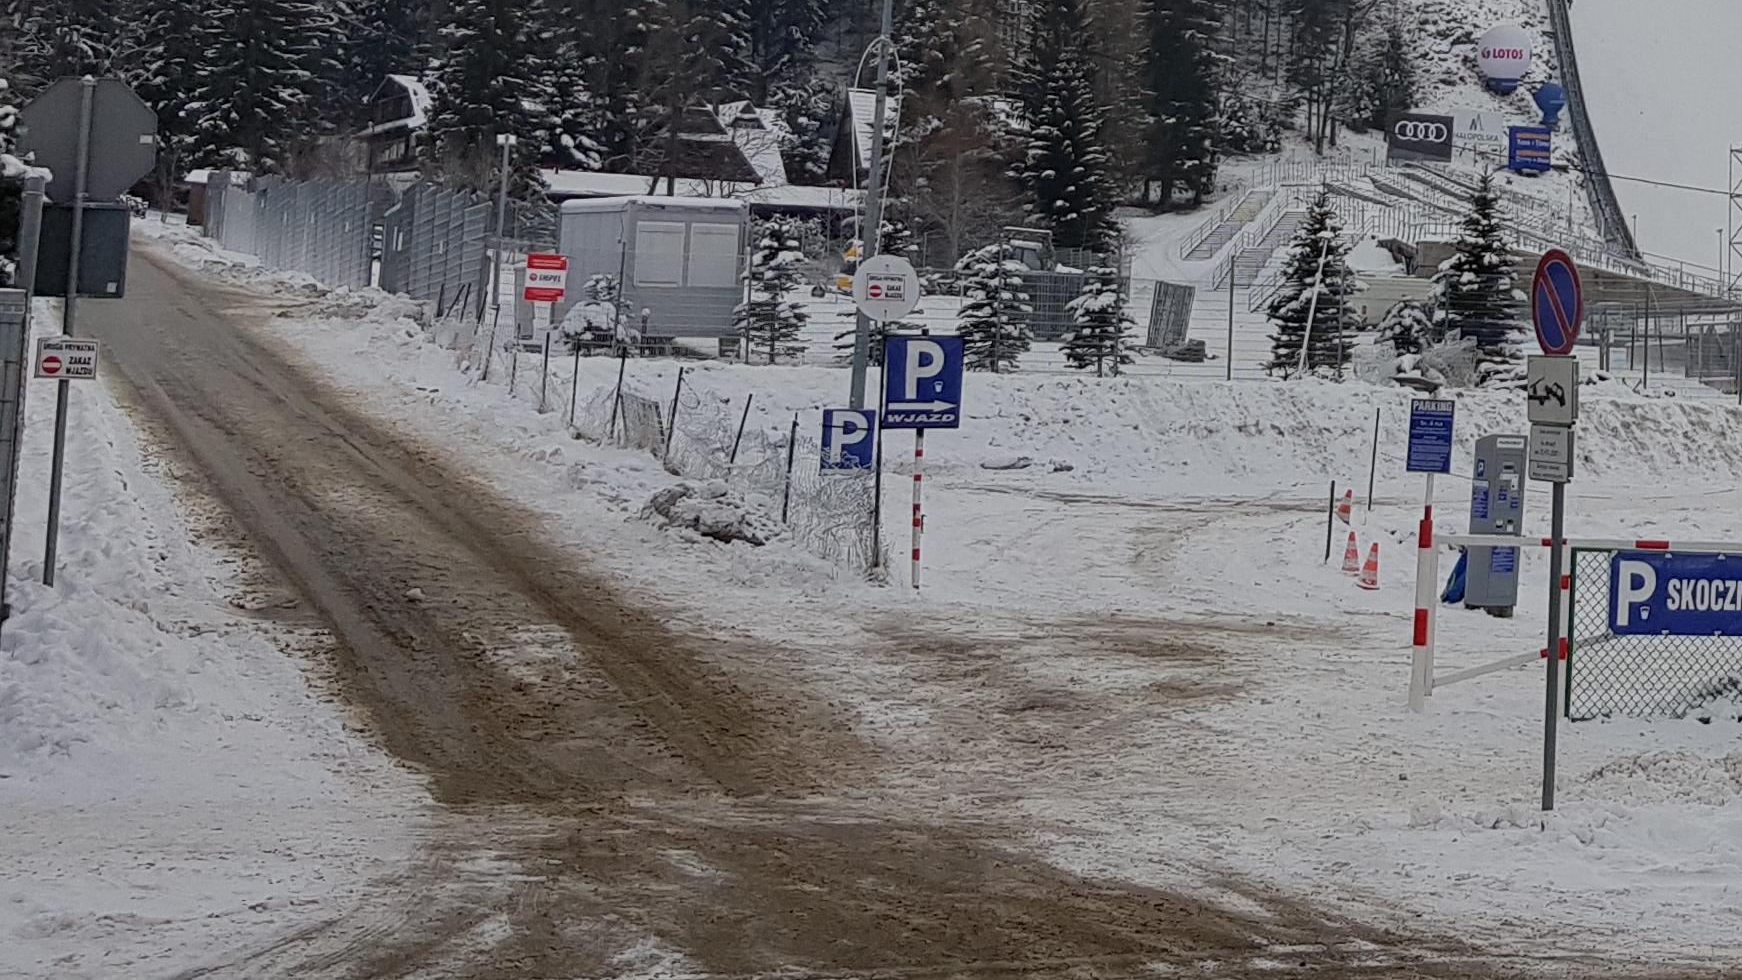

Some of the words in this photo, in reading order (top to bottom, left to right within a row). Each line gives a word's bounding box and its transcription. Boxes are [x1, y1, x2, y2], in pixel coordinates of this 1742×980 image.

[1493, 48, 1523, 59] LOTOS
[68, 356, 92, 365] ZAKAZ
[905, 340, 945, 400] P
[1413, 400, 1452, 412] PARKING
[887, 413, 956, 423] WJAZD
[829, 411, 868, 463] P
[1616, 560, 1657, 627] P
